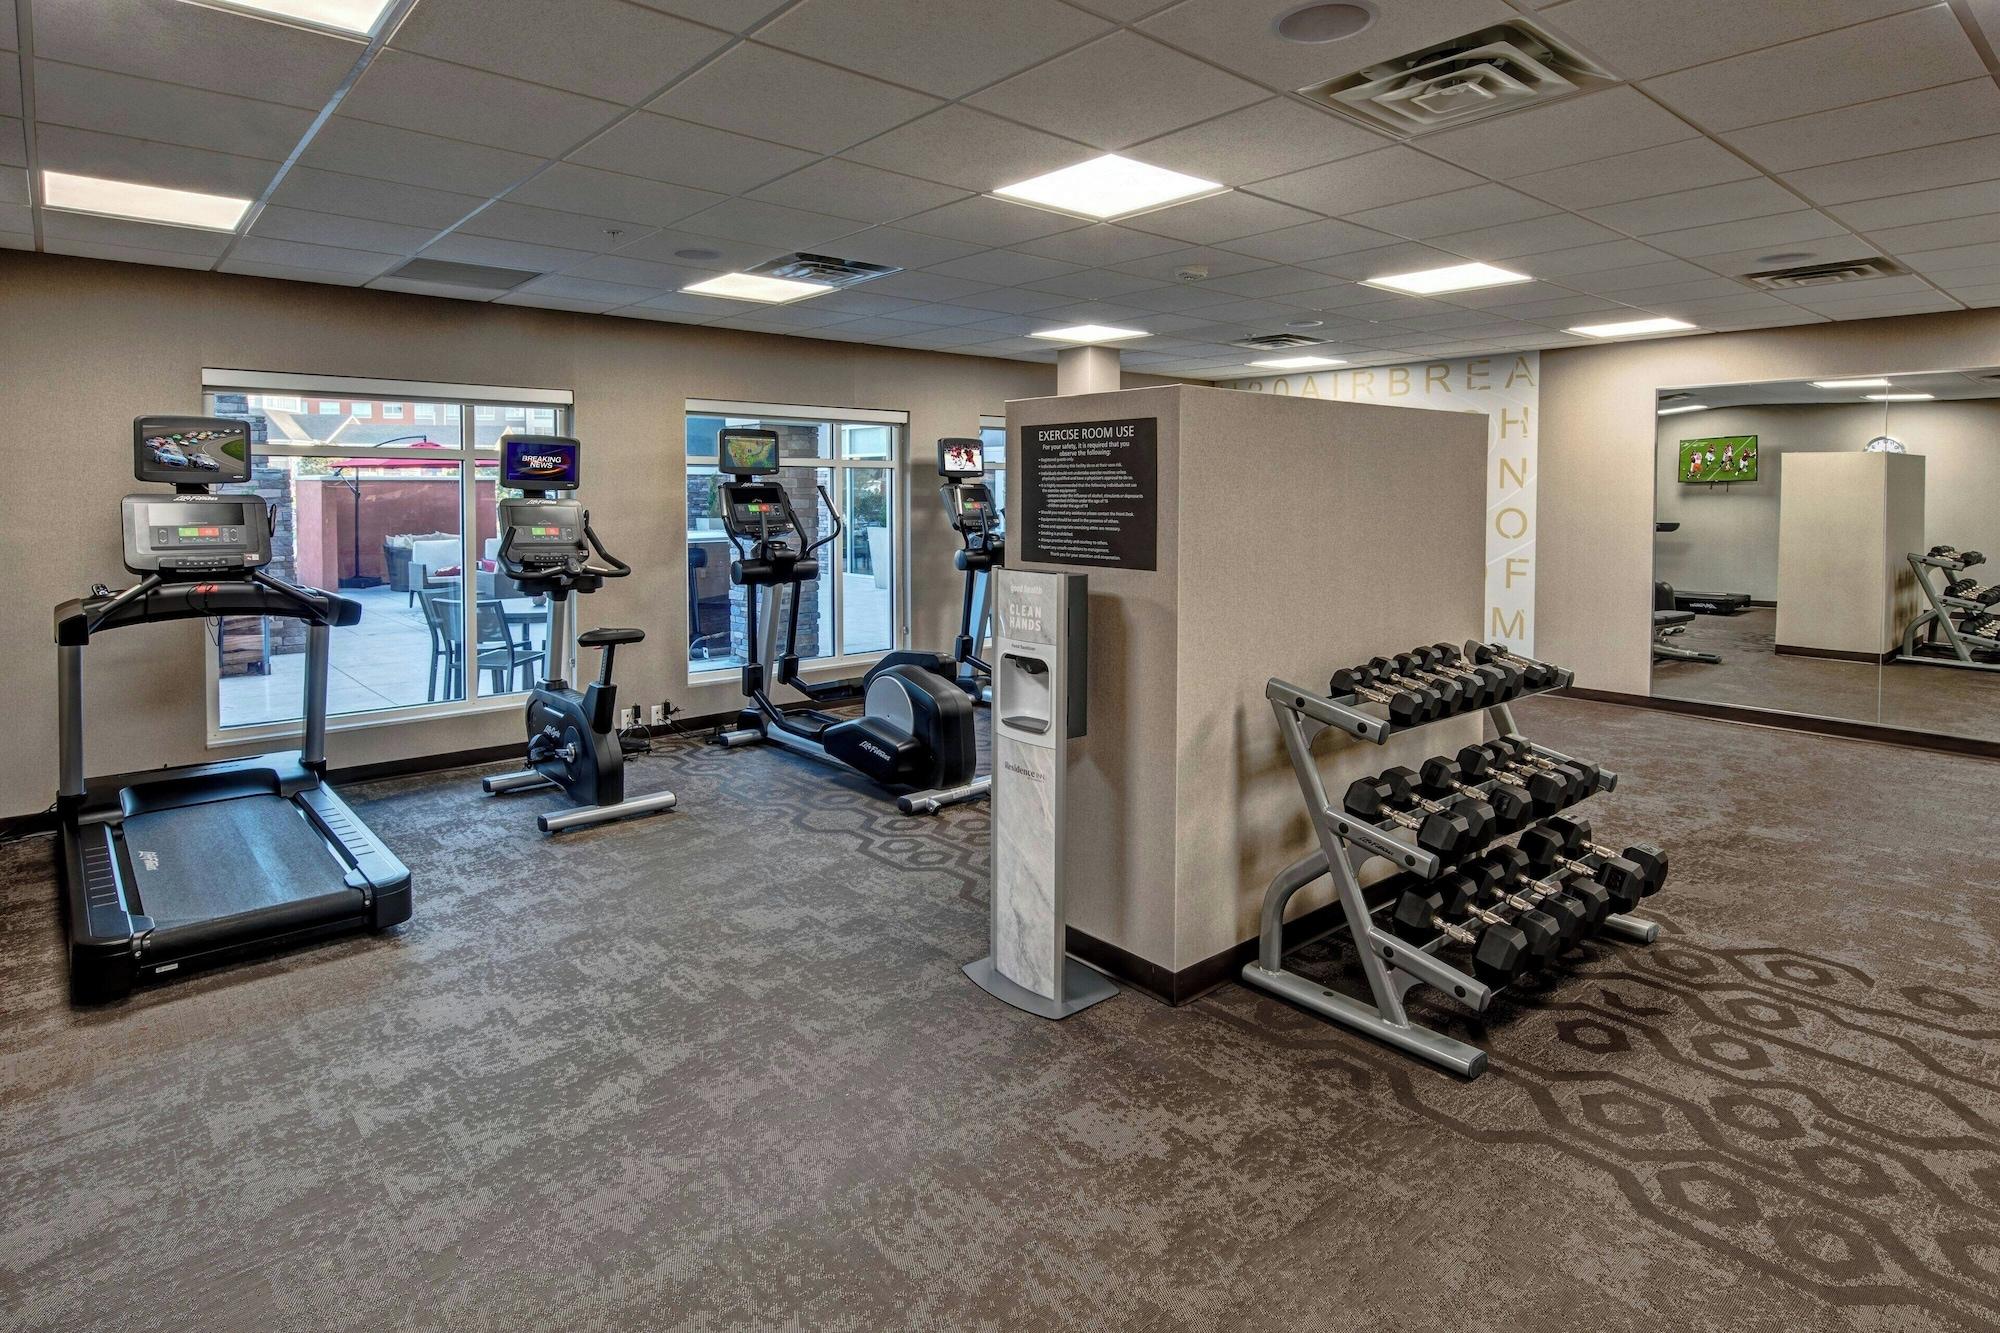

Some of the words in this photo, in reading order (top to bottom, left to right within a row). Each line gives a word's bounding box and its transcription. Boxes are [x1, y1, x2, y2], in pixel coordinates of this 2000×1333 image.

[1038, 429, 1080, 442] EXERCISE
[1081, 426, 1113, 440] ROOM
[1115, 425, 1135, 438] USE
[1051, 444, 1062, 452] your
[1087, 441, 1108, 450] required
[1120, 441, 1130, 449] you
[1078, 449, 1086, 457] the
[521, 455, 562, 463] BREAKING
[1009, 603, 1042, 618] CLEAN
[1009, 616, 1042, 631] HANDS
